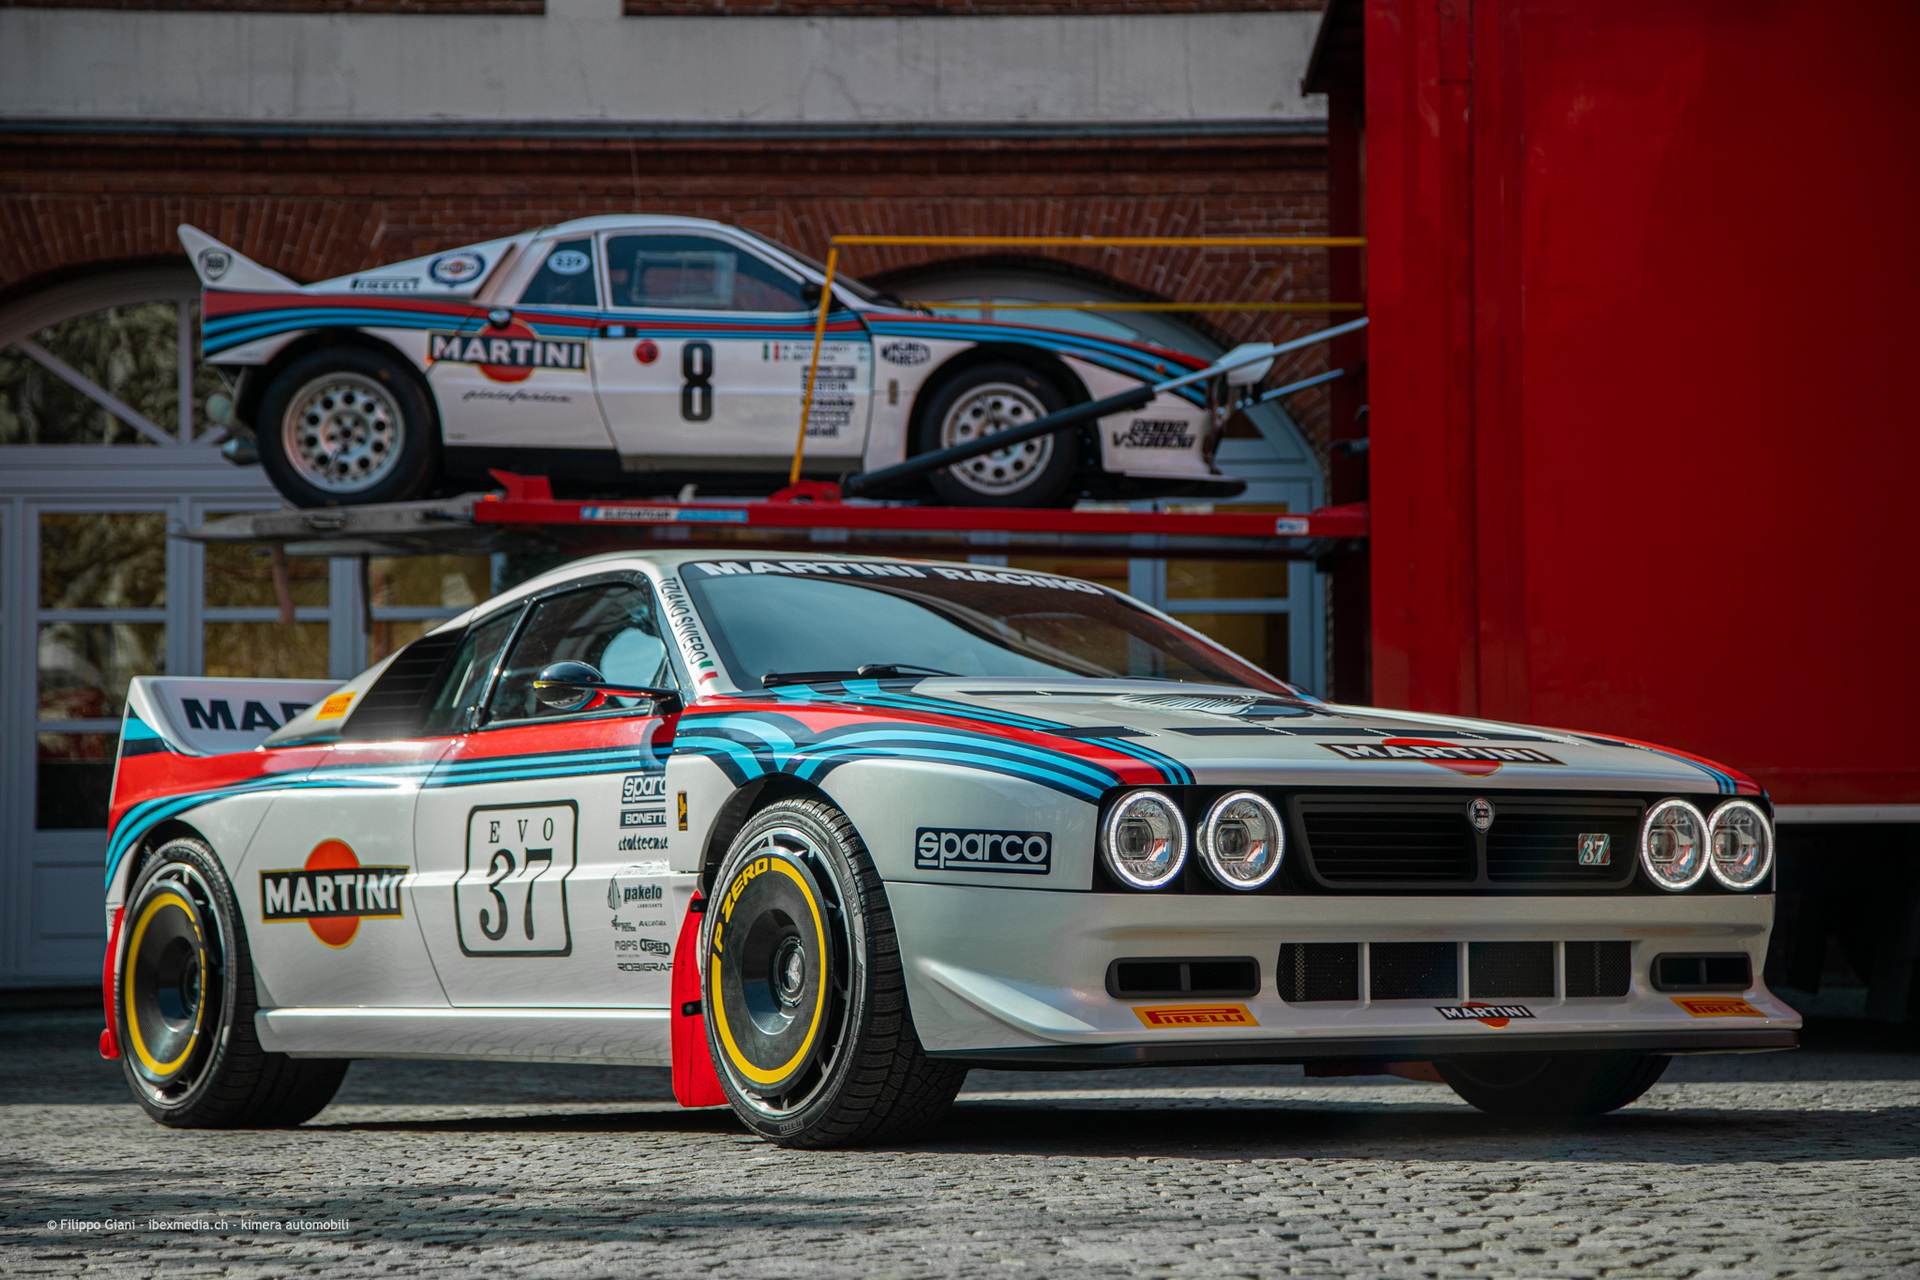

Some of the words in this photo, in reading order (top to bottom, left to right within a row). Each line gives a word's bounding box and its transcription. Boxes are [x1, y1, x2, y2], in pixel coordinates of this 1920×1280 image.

[432, 336, 583, 368] MARTINI
[681, 340, 713, 421] 8
[694, 561, 928, 578] MARTINI
[932, 567, 1104, 595] RACING
[658, 576, 690, 618] TIZIANO
[674, 616, 709, 665] SIVIERO
[1331, 744, 1551, 762] MARTINI
[488, 817, 554, 844] EVO
[918, 831, 1048, 869] sparco
[1583, 839, 1605, 863] 37
[264, 873, 406, 914] MARTINI
[479, 847, 553, 942] 37
[624, 883, 663, 904] pakelo
[713, 922, 724, 953] P
[721, 857, 769, 924] ZERO
[1144, 1008, 1247, 1025] PIRELLI
[1440, 1006, 1531, 1018] MARTINI
[1680, 1001, 1757, 1014] PIRELLI
